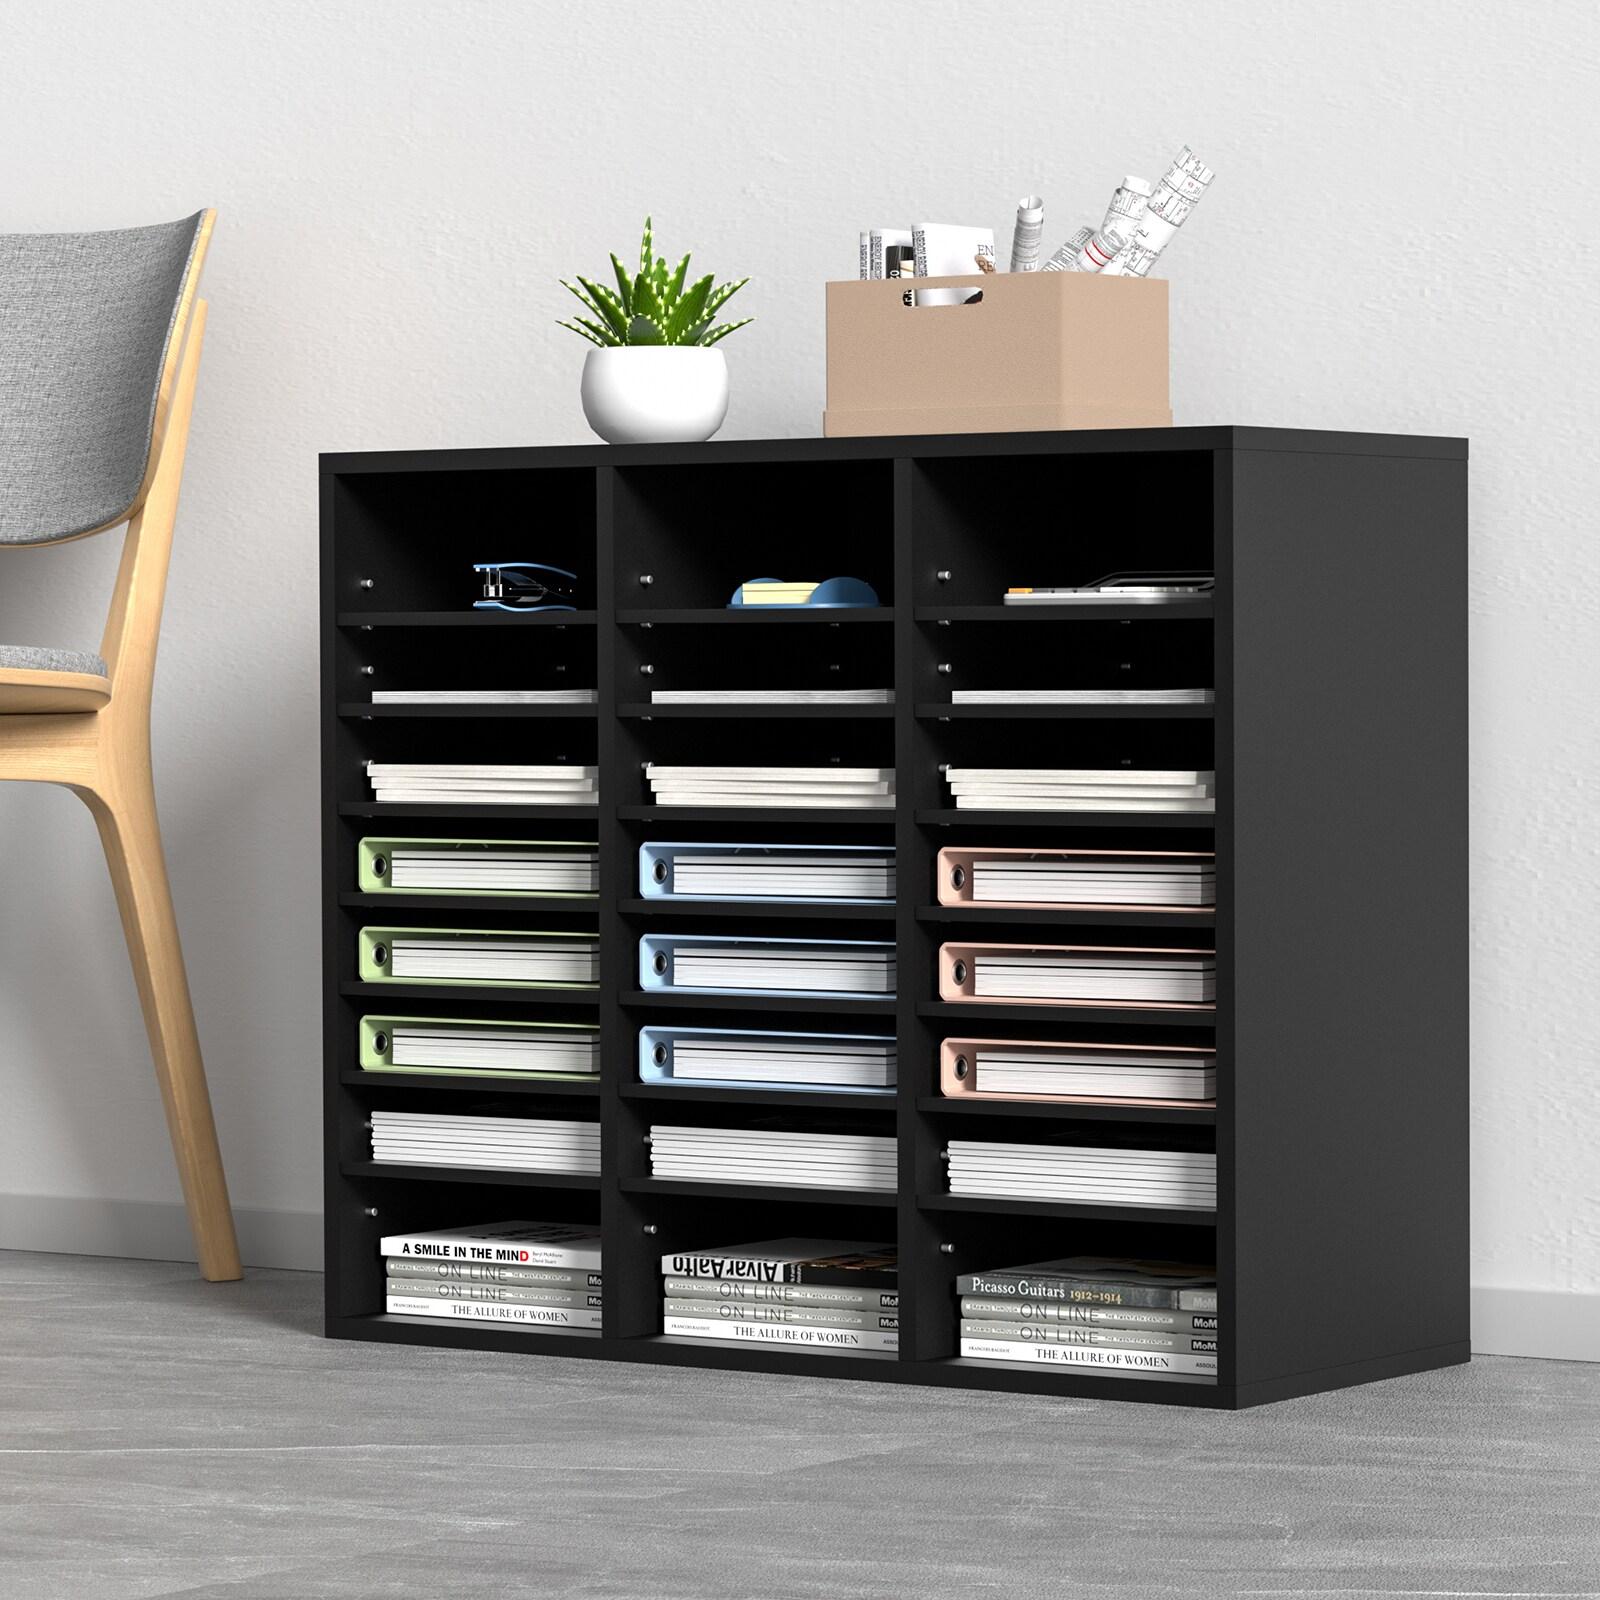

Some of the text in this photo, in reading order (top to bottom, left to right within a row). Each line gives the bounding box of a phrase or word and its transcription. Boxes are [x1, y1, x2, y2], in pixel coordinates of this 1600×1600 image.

[402, 1243, 529, 1262] A SMILE IN THE MIND
[438, 1262, 462, 1278] ON
[470, 1265, 507, 1281] LINE
[439, 1284, 462, 1297] ON
[470, 1287, 507, 1301] LINE
[720, 1282, 745, 1298] ON
[754, 1284, 794, 1302] LINE
[972, 1277, 1016, 1295] Picasso
[1018, 1280, 1066, 1298] Guitars
[451, 1304, 568, 1322] THE ALLURE OF WOMEN
[720, 1304, 744, 1319] ON
[753, 1307, 793, 1322] LINE
[1020, 1303, 1047, 1319] ON
[1058, 1305, 1100, 1323] LINE
[733, 1326, 859, 1345] THE ALLURE OF WOMEN
[1020, 1327, 1047, 1340] ON
[1057, 1329, 1099, 1345] LINE
[1035, 1348, 1169, 1368] THE ALLURE OF WOMEN
